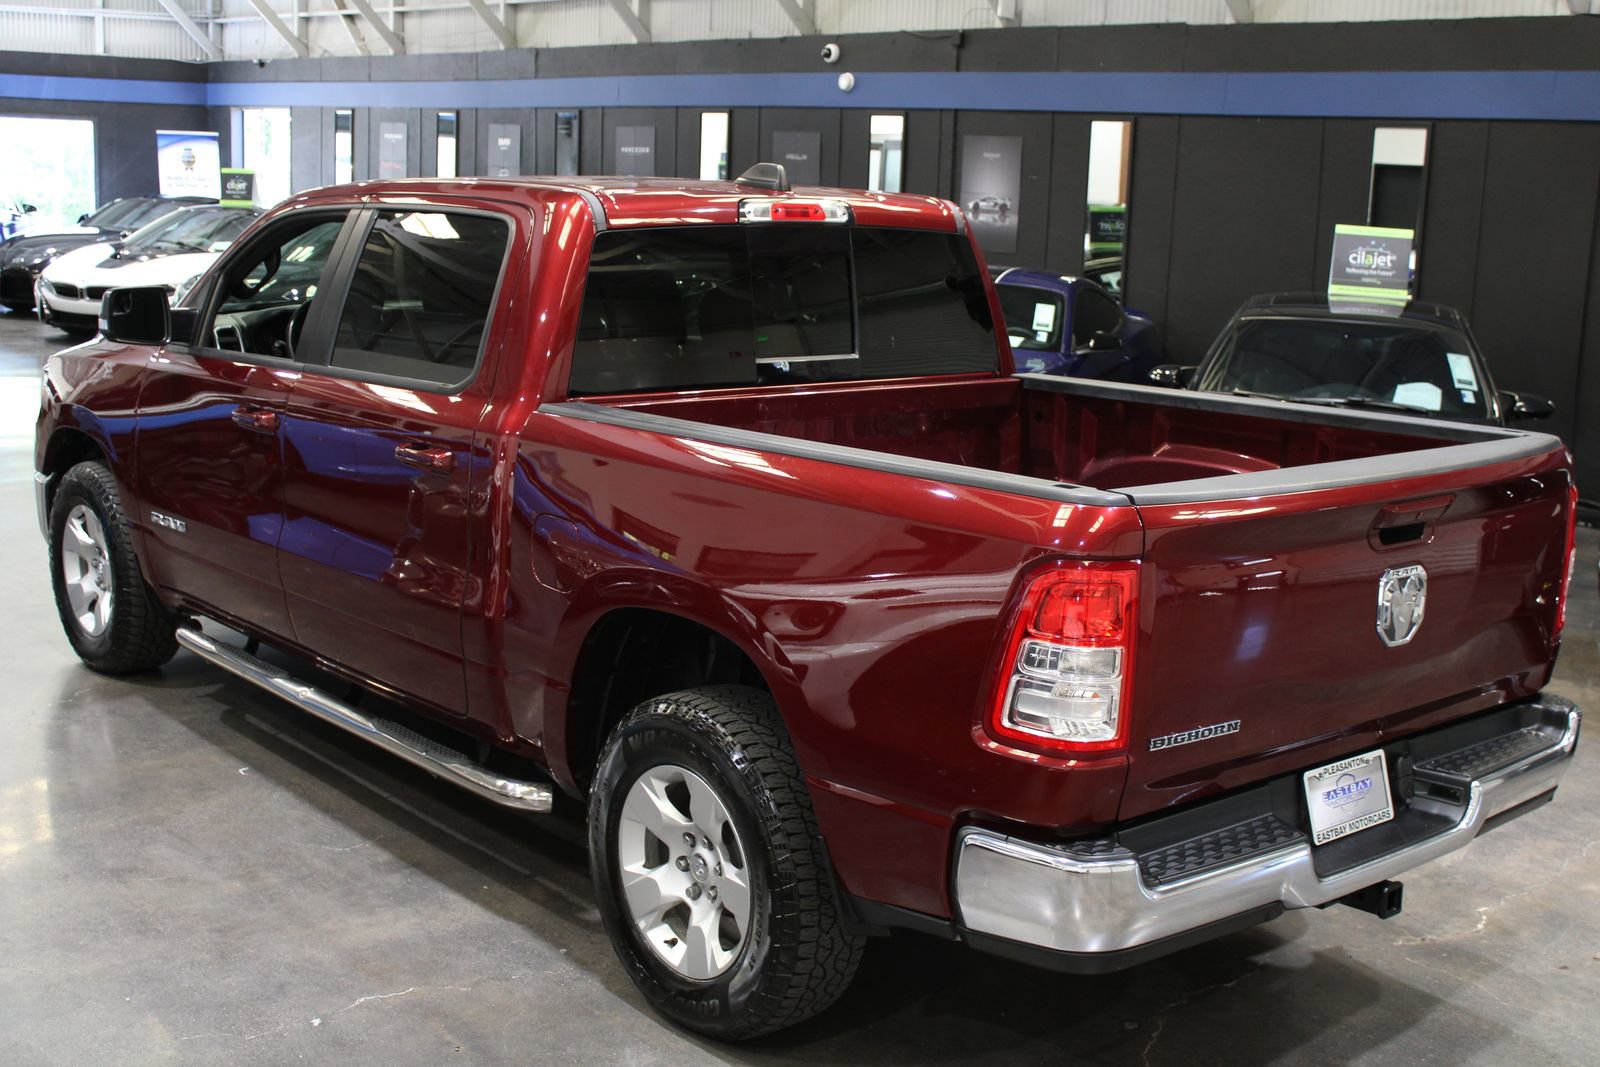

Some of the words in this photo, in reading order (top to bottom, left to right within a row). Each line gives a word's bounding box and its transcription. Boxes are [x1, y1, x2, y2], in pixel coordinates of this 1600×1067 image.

[151, 511, 187, 533] RAM
[1391, 567, 1419, 577] RAM
[1150, 720, 1241, 751] BIGHORN
[1323, 757, 1366, 775] PLEASANTON
[1322, 779, 1372, 801] EASTBAY
[1316, 825, 1348, 843] EASTBAY
[1348, 810, 1391, 832] MOTORCARS
